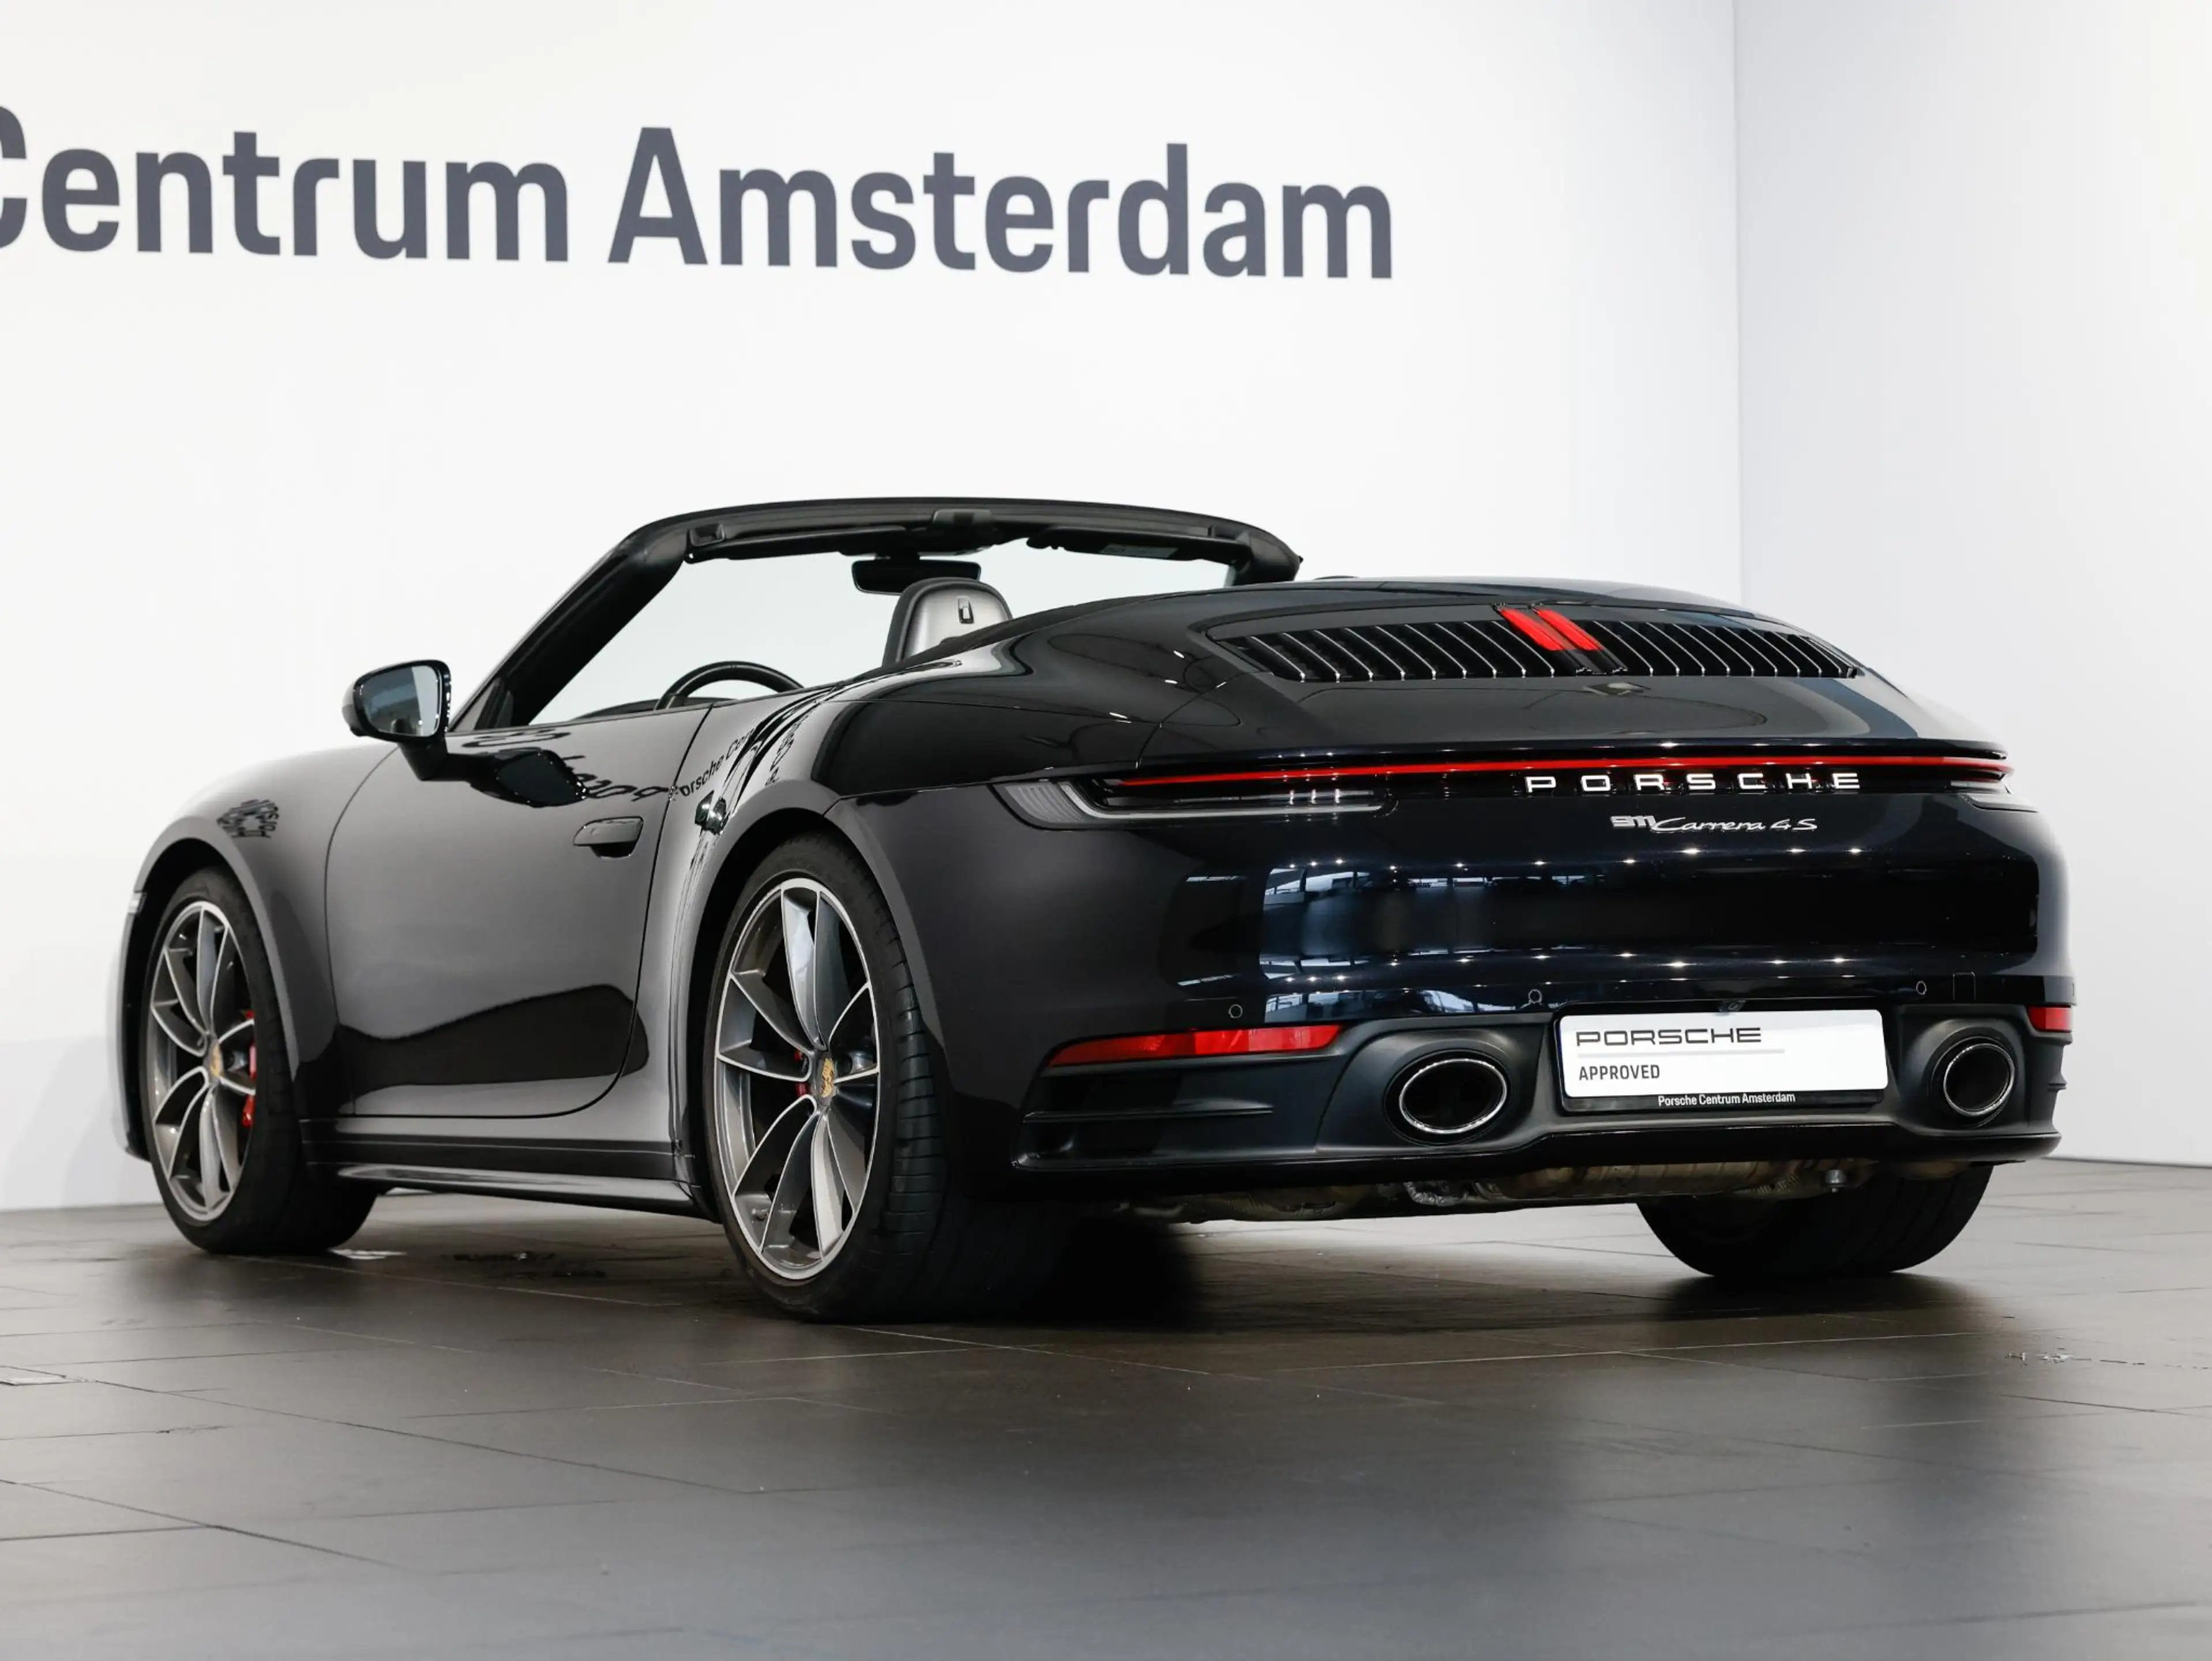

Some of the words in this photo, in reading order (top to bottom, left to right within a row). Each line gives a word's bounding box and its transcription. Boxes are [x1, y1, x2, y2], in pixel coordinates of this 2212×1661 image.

[608, 127, 1392, 279] Amsterdam
[1525, 773, 1861, 792] PORSCHE
[1610, 815, 1656, 828] 911
[1651, 816, 1766, 833] Carrera
[1576, 1027, 1762, 1047] PORSCHE
[1579, 1065, 1660, 1081] APPROVED
[1658, 1094, 1698, 1107] Porsche
[1699, 1093, 1741, 1106] Centrum
[1742, 1092, 1796, 1104] Amsterdam
